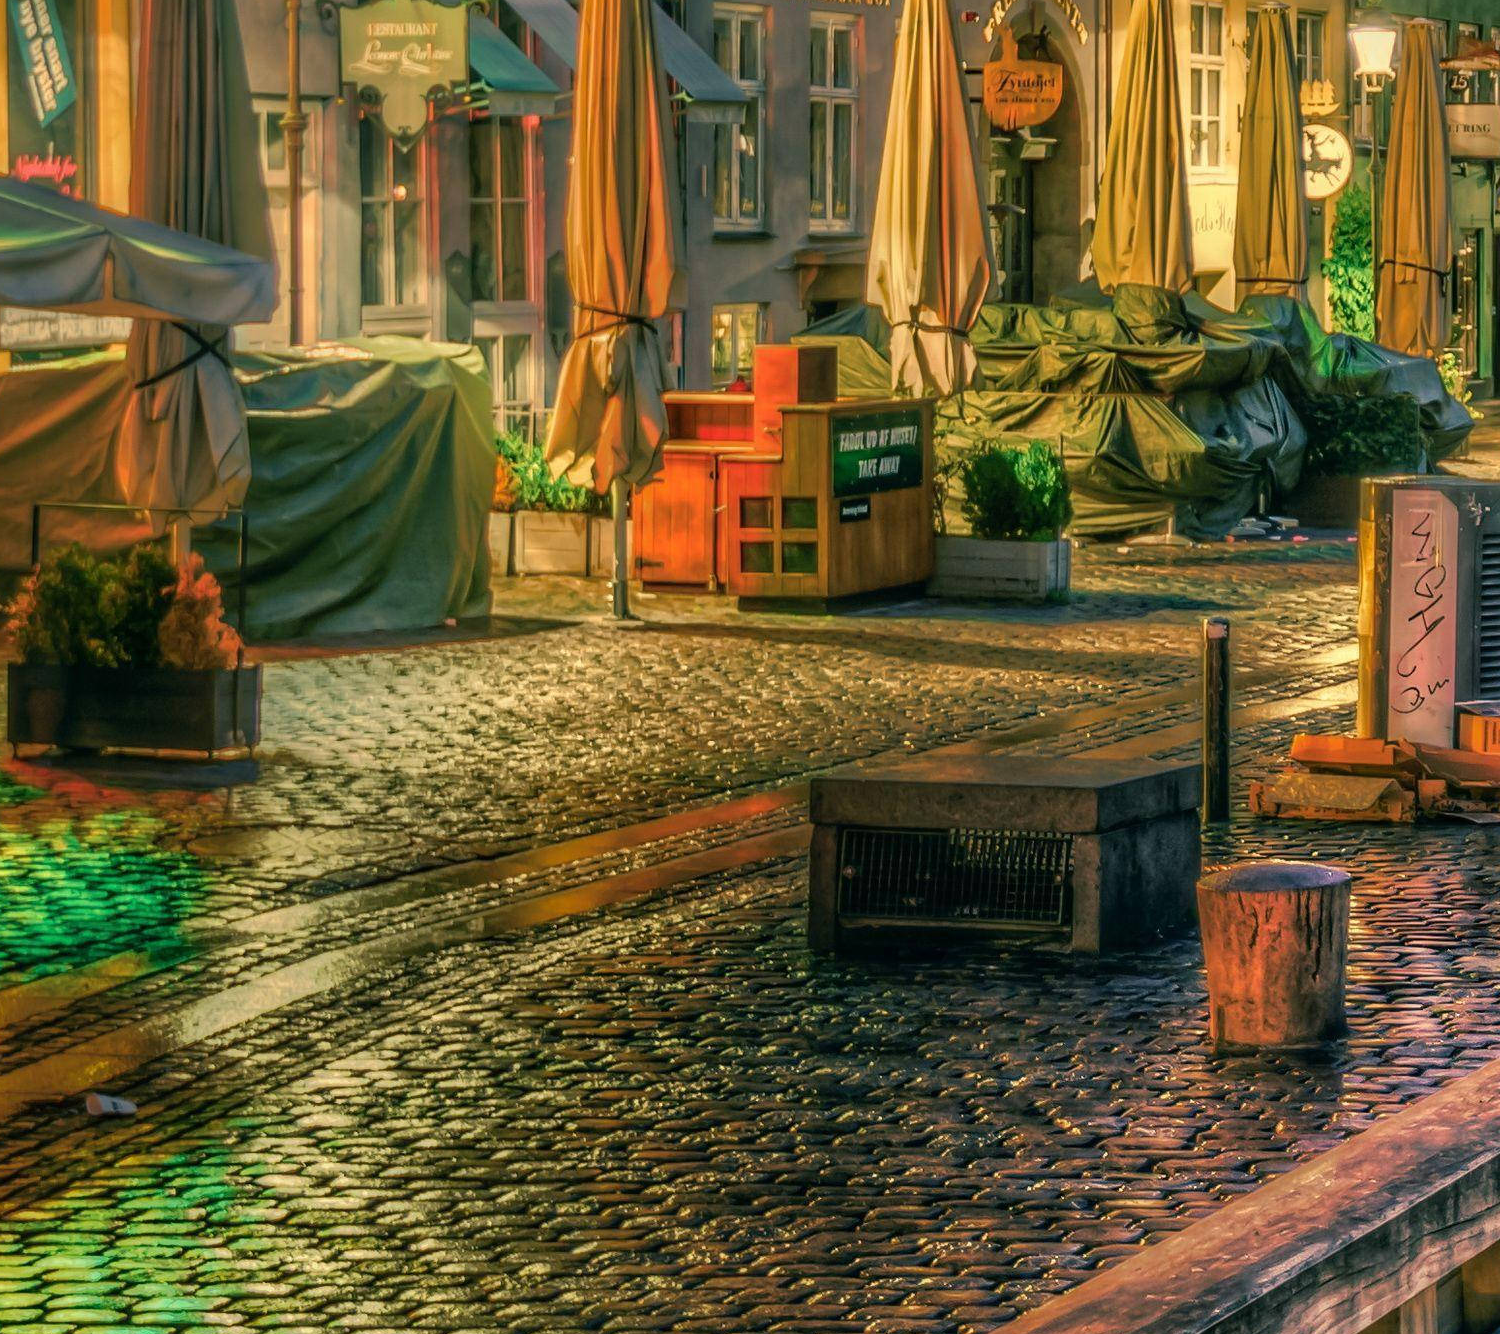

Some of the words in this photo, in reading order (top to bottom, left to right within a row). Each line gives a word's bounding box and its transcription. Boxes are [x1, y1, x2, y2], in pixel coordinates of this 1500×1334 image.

[367, 22, 439, 37] RESTAURANT
[1450, 74, 1468, 90] 15
[858, 458, 878, 479] TAKE
[879, 455, 900, 475] AWAY
